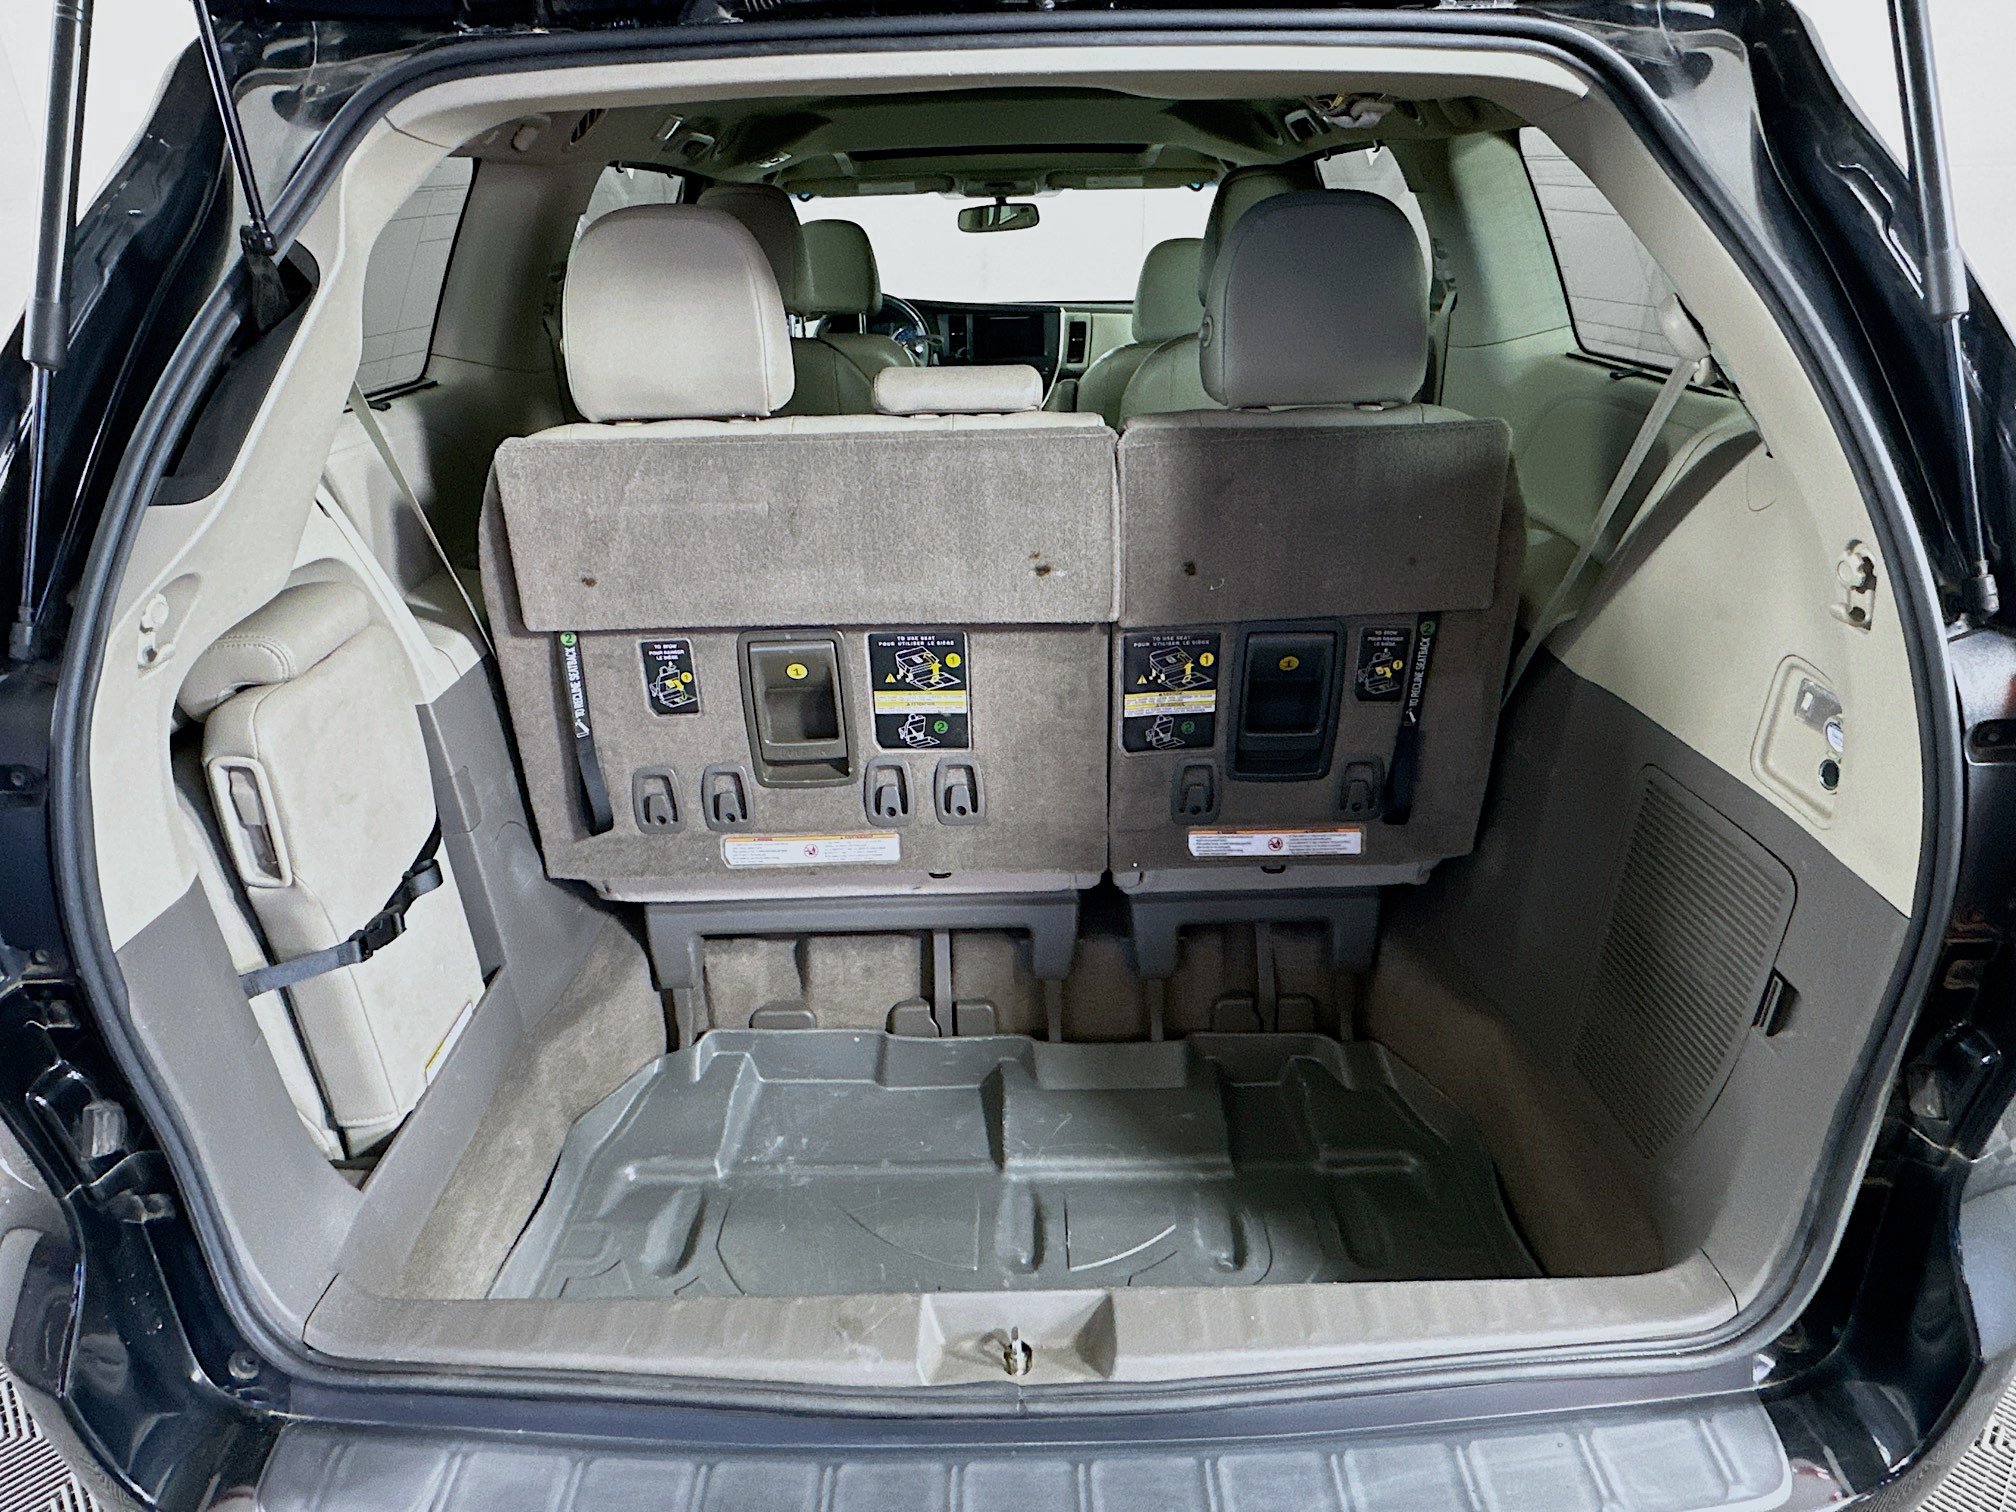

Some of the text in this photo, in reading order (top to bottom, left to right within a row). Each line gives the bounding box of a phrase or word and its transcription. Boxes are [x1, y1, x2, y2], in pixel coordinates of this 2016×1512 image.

[564, 647, 580, 681] SEATBACK
[1409, 637, 1431, 707] TO RECLINE SEATBACK
[574, 708, 585, 718] TO
